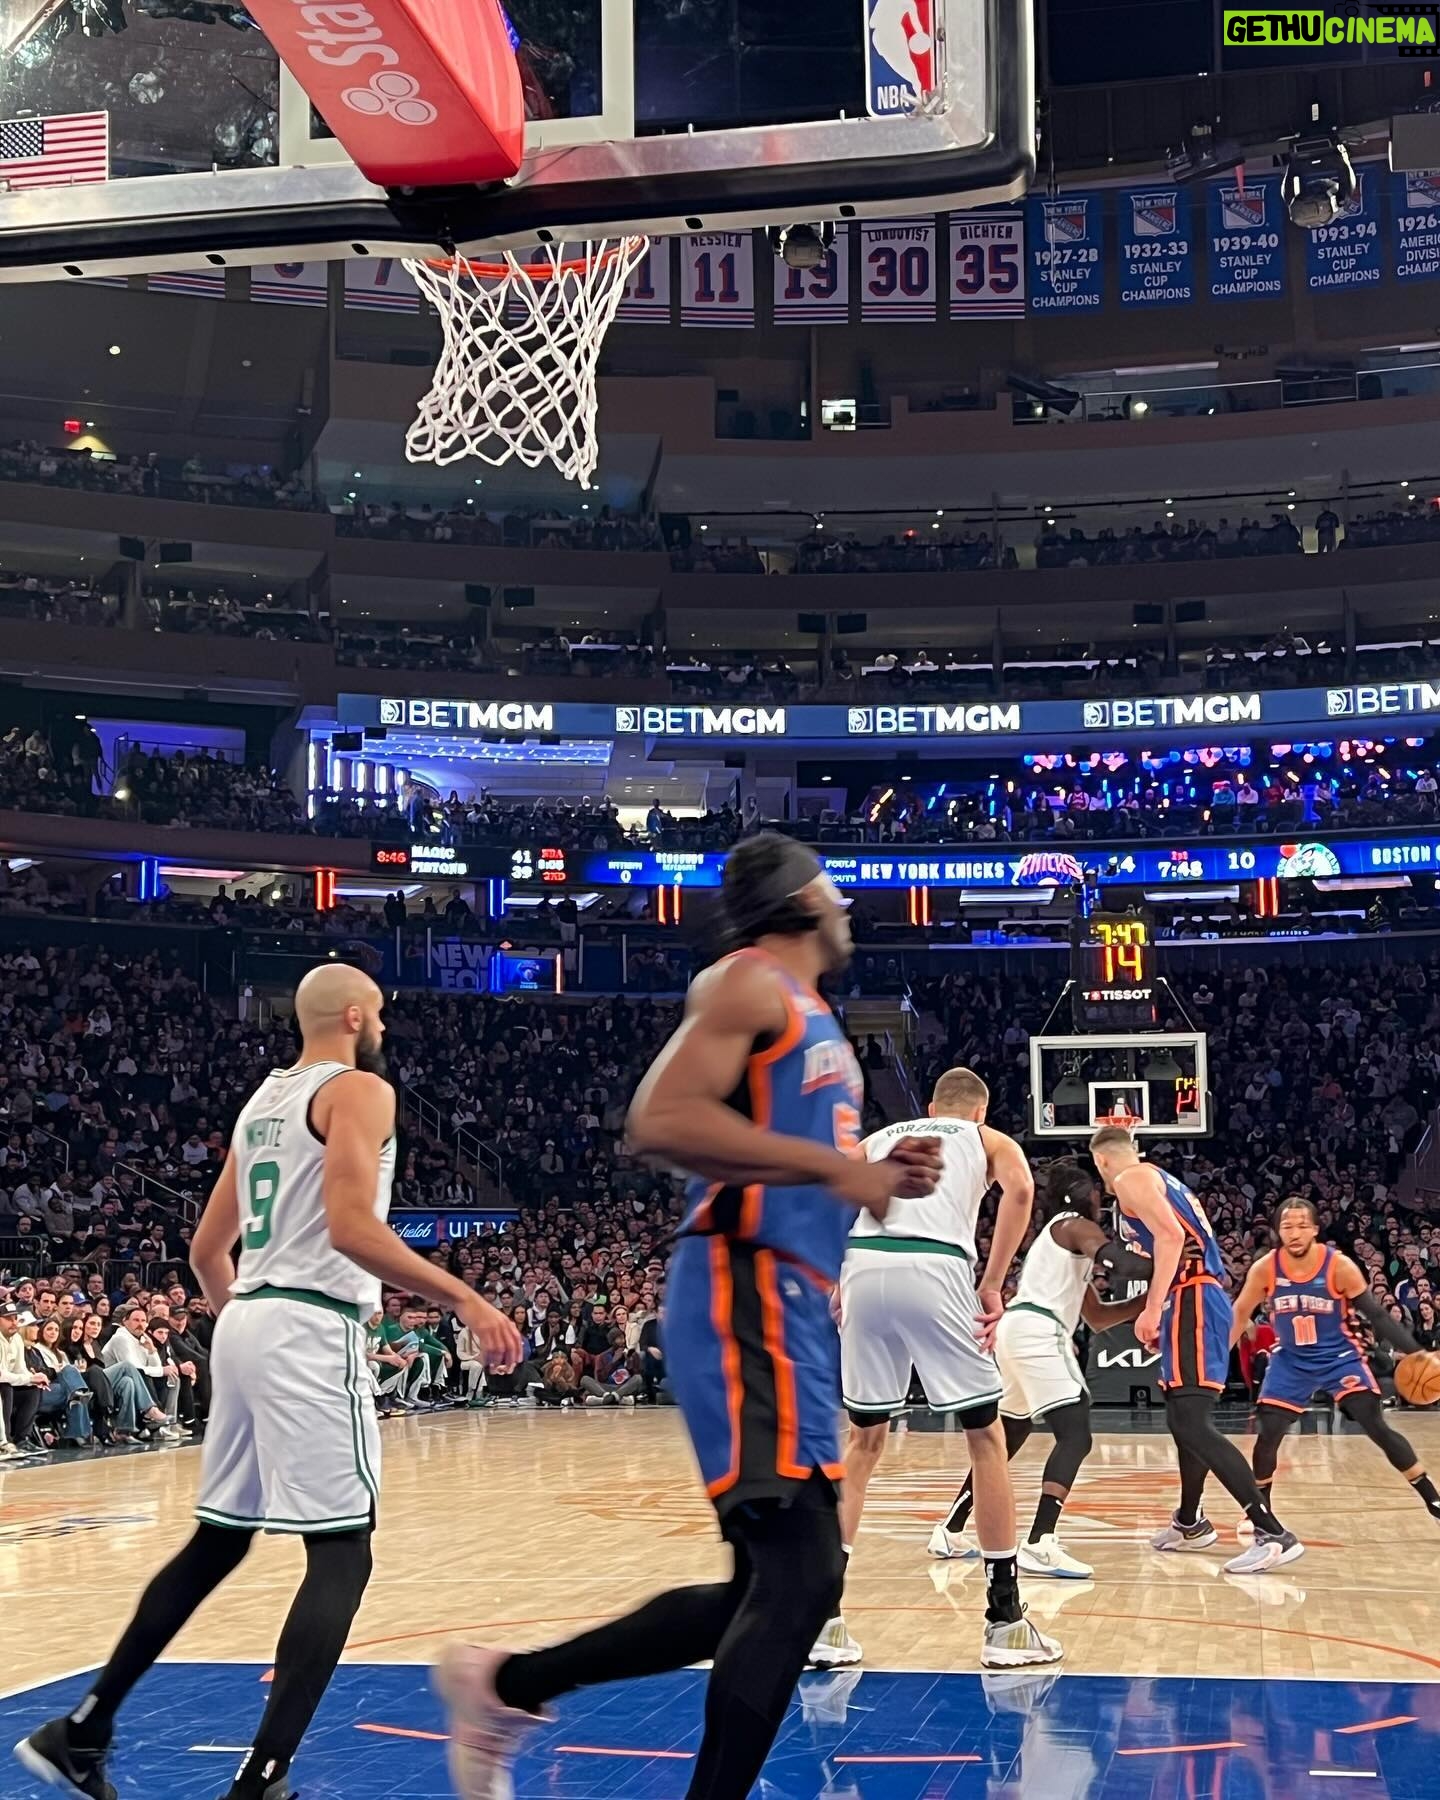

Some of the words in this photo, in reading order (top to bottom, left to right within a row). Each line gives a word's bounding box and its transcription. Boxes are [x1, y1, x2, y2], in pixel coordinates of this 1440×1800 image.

[292, 0, 400, 65] Sta
[877, 84, 910, 110] NBA
[868, 227, 930, 243] LUNDQVIST
[960, 225, 1013, 241] RICHTER
[1311, 222, 1377, 243] 1993-94
[1124, 241, 1189, 259] 1932-33
[1213, 233, 1279, 252] 1939-40
[1317, 243, 1370, 259] STANLEY
[1035, 249, 1099, 266] 1927-28
[1219, 254, 1272, 268] STANLEY
[1332, 258, 1357, 270] CUP
[868, 246, 929, 297] 30
[955, 244, 1019, 295] 35
[1041, 268, 1092, 282] STANLEY
[1130, 261, 1182, 275] STANLEY
[1234, 269, 1259, 280] CUP
[695, 252, 739, 302] 11
[1144, 275, 1168, 287] CUP
[1310, 269, 1380, 288] CHAMPIONS
[1054, 282, 1078, 294] CUP
[1122, 287, 1191, 301] CHAMPIONS
[1212, 281, 1281, 295] CHAMPIONS
[1032, 294, 1100, 308] CHAMPIONS
[409, 701, 554, 731] BETMGM
[1112, 694, 1261, 727] BETMGM
[644, 706, 786, 734] BETMGM
[876, 705, 1021, 734] BETMGM
[376, 851, 407, 863] 8:46
[411, 845, 455, 860] MAGIC
[511, 850, 532, 864] 41
[1228, 852, 1255, 869] 10
[1371, 846, 1431, 865] BOSTON
[511, 865, 533, 879] 39
[861, 864, 893, 879] NEW
[898, 863, 925, 880] YORK
[945, 862, 1005, 880] KNICKS
[1019, 853, 1084, 881] KNICKS
[1158, 861, 1203, 877] 7:48
[620, 870, 632, 884] 0
[674, 872, 684, 883] 4
[831, 874, 857, 883] OUTS
[1097, 922, 1146, 946] 7:47
[430, 943, 494, 968] NEW
[1105, 945, 1143, 982] 14
[1102, 989, 1152, 1000] TISSOT
[246, 1161, 280, 1250] 9
[1127, 1280, 1148, 1300] APP
[1292, 1315, 1318, 1346] 11
